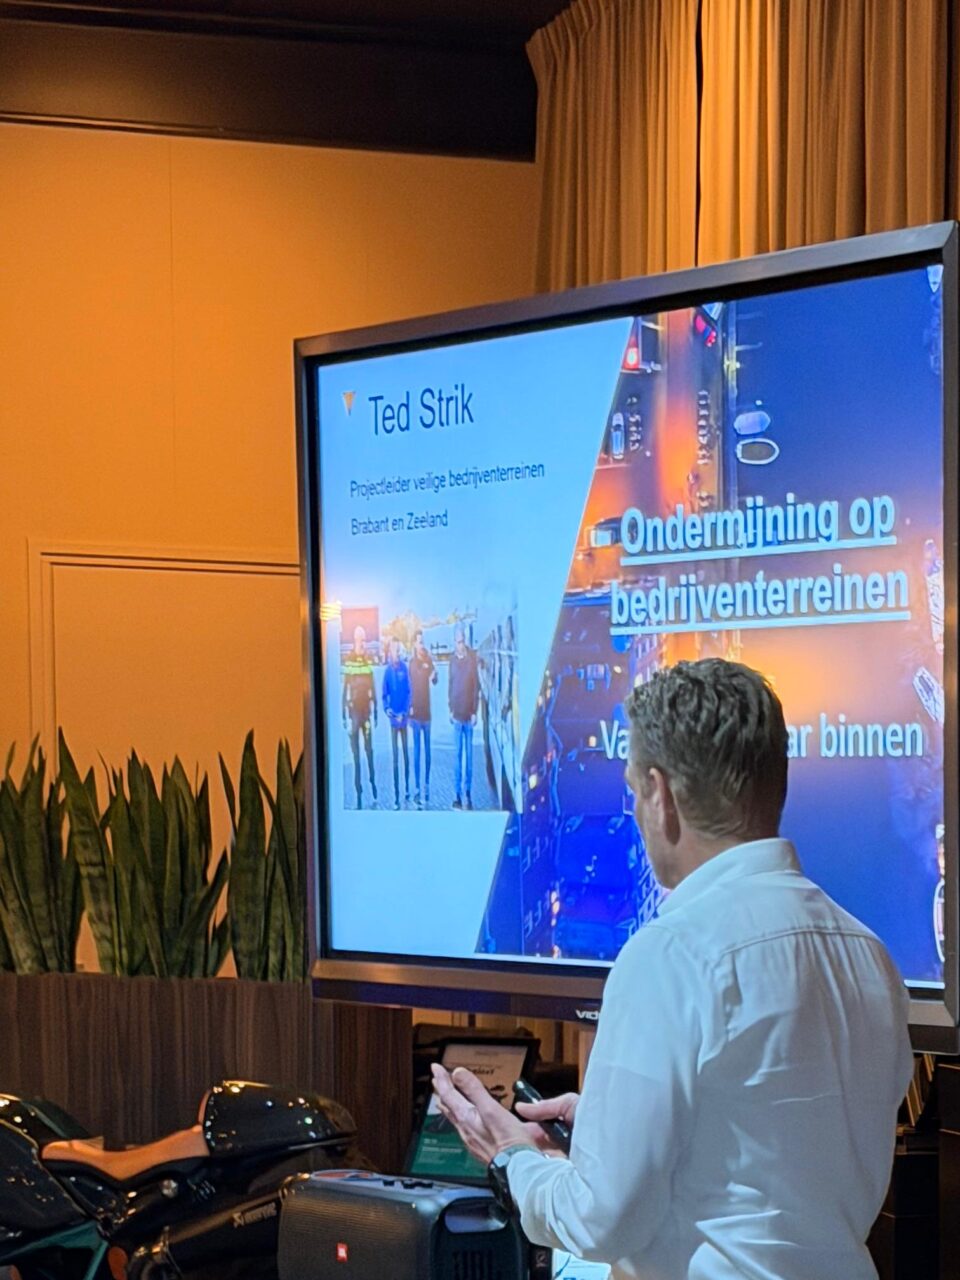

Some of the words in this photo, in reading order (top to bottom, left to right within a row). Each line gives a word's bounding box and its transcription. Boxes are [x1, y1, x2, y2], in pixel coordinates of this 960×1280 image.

[368, 391, 410, 436] Ted
[419, 383, 474, 429] Strik
[350, 478, 410, 500] Projectleider
[413, 471, 446, 493] veilige
[449, 462, 545, 489] bedrijventerreinen
[351, 517, 390, 536] Brabant
[391, 518, 404, 532] en
[406, 508, 449, 531] Zeeland
[620, 492, 839, 555] Ondermijning
[849, 495, 896, 541] op
[610, 562, 909, 624] bedrijventerreinen
[600, 720, 629, 760] Va
[786, 723, 813, 758] ar
[819, 713, 924, 758] binnen
